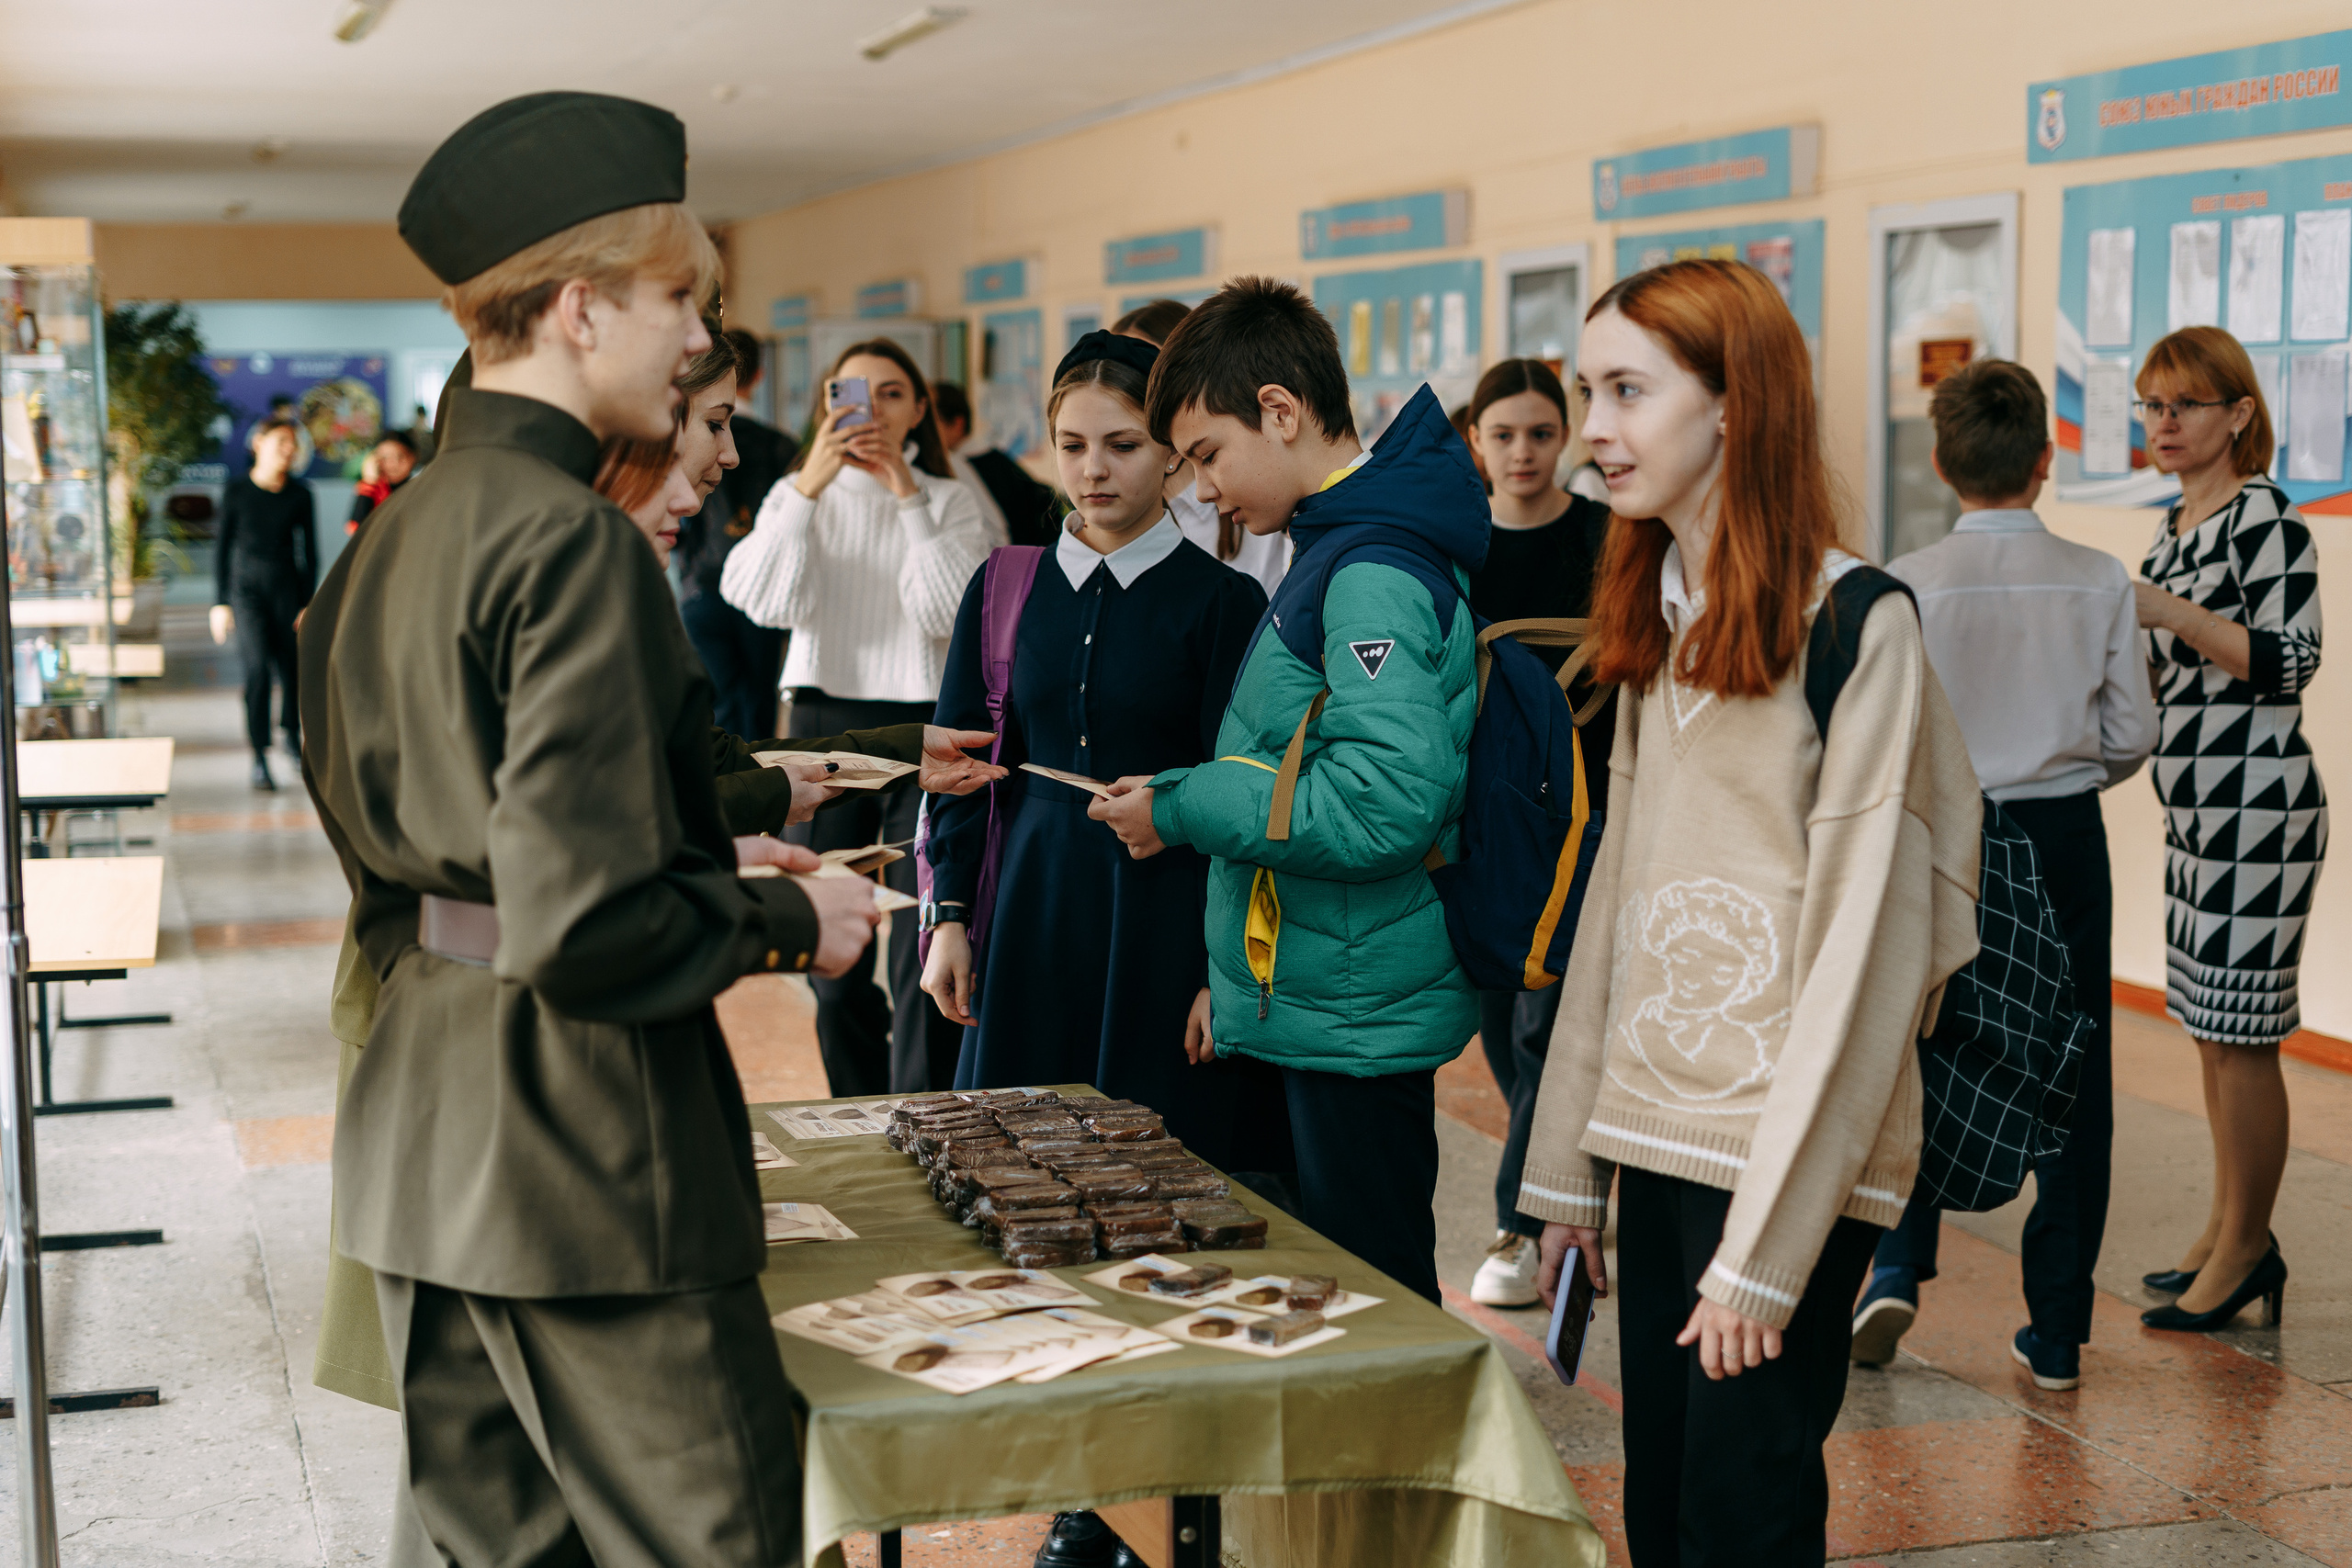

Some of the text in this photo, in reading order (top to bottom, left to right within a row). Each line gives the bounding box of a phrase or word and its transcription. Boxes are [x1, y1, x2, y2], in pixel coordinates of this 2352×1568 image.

[2098, 65, 2340, 128] СОЮЗ ЮНЫХ ГРАЖДАН РОССИИ
